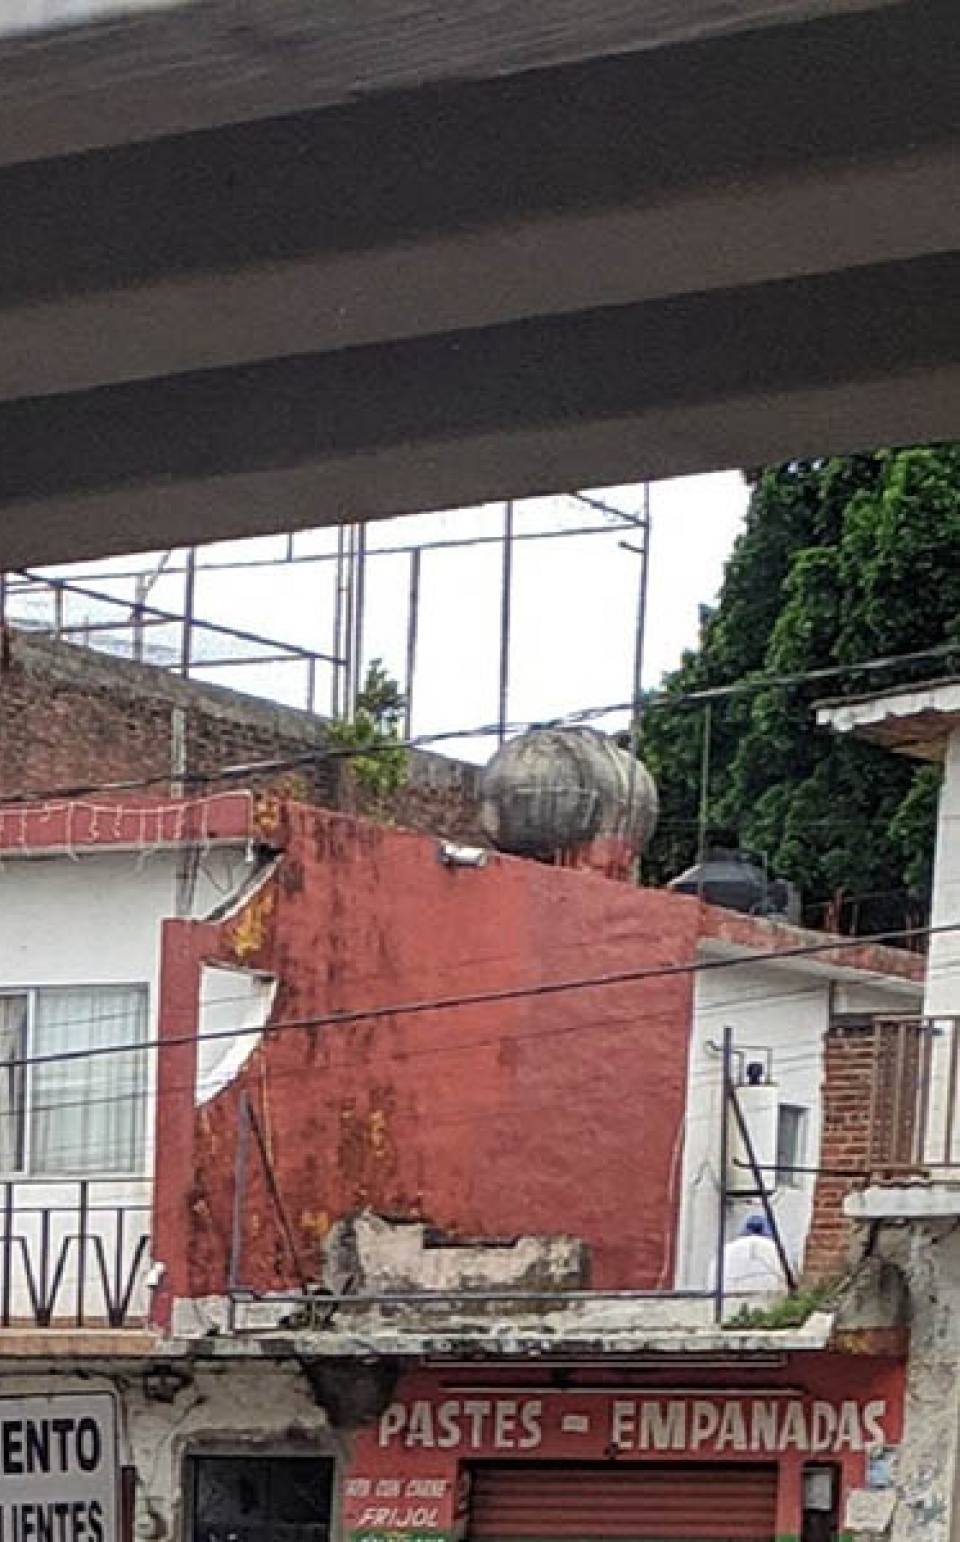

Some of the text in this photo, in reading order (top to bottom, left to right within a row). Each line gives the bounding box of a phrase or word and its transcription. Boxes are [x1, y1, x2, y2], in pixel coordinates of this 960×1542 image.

[378, 1400, 542, 1447] PASTES
[611, 1400, 887, 1453] EMPANADAS
[356, 1507, 439, 1528] FRIJOL
